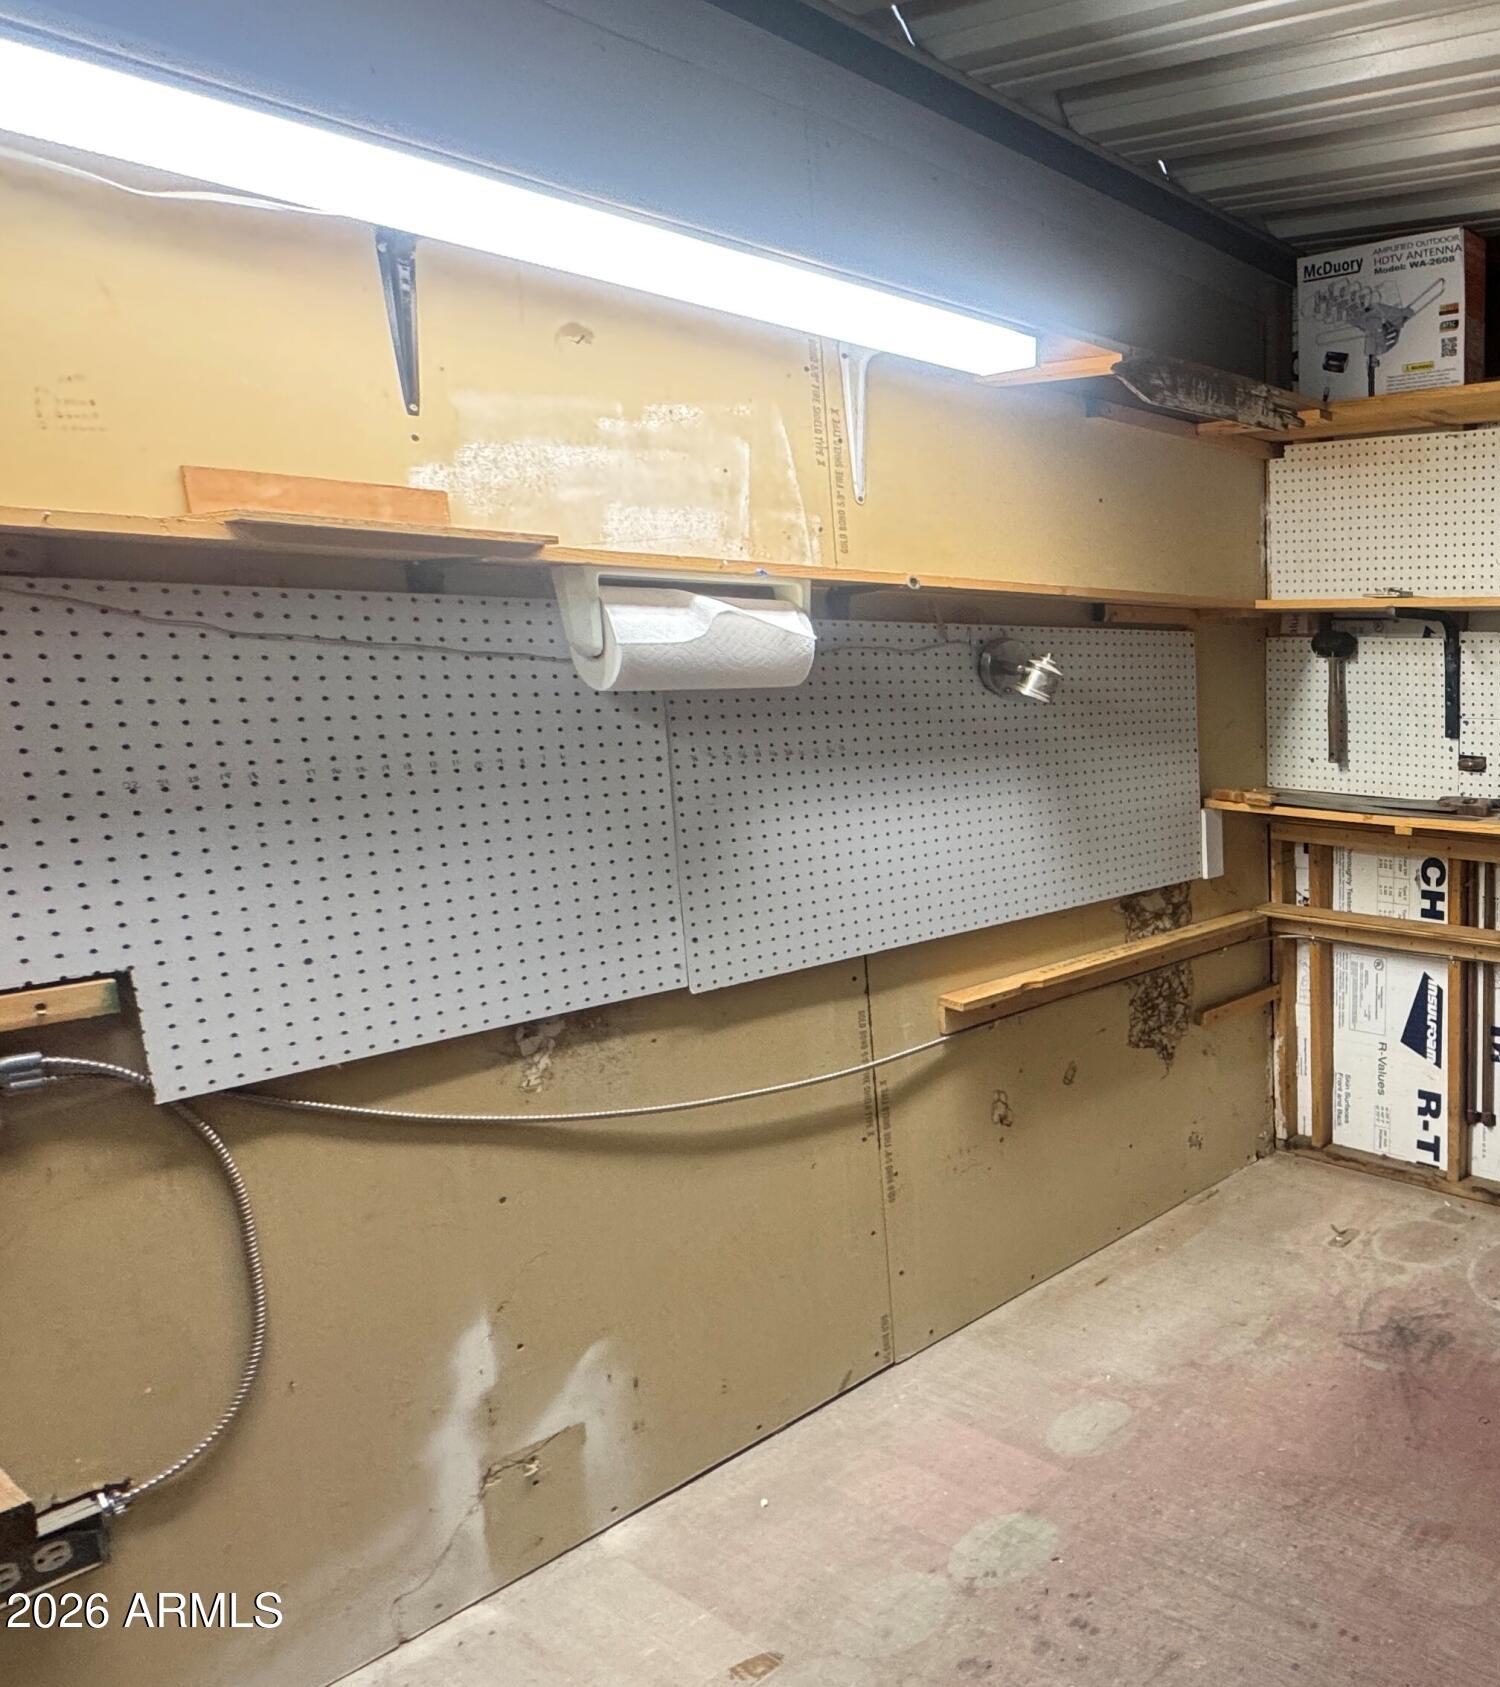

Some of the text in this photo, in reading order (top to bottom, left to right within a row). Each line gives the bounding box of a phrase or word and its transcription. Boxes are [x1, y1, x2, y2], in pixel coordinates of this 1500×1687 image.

[1373, 244, 1462, 267] HDTV ANTENNA
[1303, 257, 1363, 279] McDuory
[1378, 1042, 1387, 1096] R-Values
